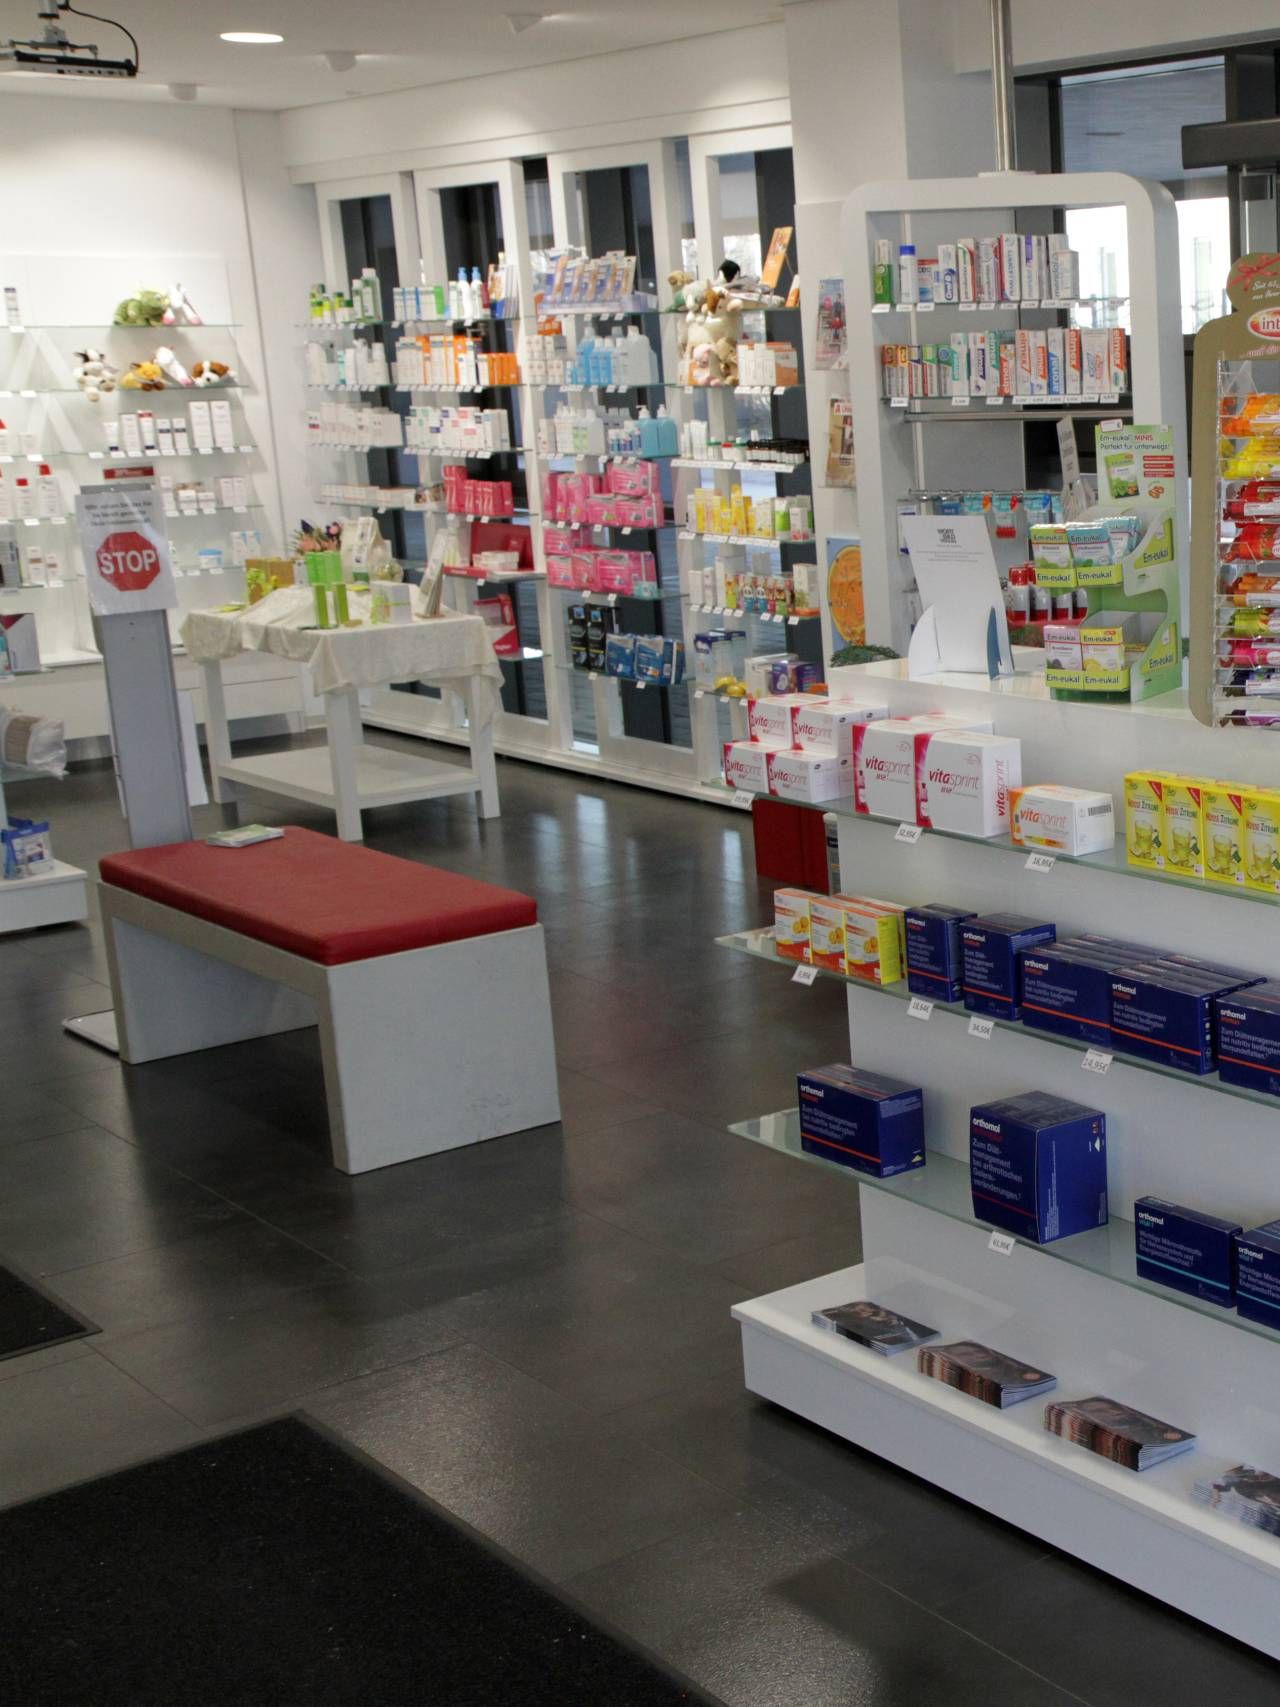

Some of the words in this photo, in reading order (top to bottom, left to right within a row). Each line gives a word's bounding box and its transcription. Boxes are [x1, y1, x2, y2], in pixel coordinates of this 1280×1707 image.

[100, 549, 157, 575] STOP
[1037, 573, 1072, 582] Em-eukal
[1077, 570, 1113, 581] Em-eukal
[1046, 673, 1080, 684] Em-eukal
[1084, 675, 1119, 685] Em-eukal
[864, 755, 912, 777] vitasprint
[928, 767, 980, 791] vitasprint
[994, 759, 1006, 817] vitasprint
[1019, 807, 1069, 829] vitasprint
[963, 931, 986, 943] orthomol
[1024, 959, 1049, 971] orthomol
[1112, 983, 1137, 995] orthomol
[1220, 1008, 1246, 1021] orthomol
[800, 1084, 824, 1098] orthomol
[972, 1118, 1001, 1133] orthomol
[1138, 1212, 1164, 1226] orthomol
[1238, 1247, 1264, 1261] orthomol
